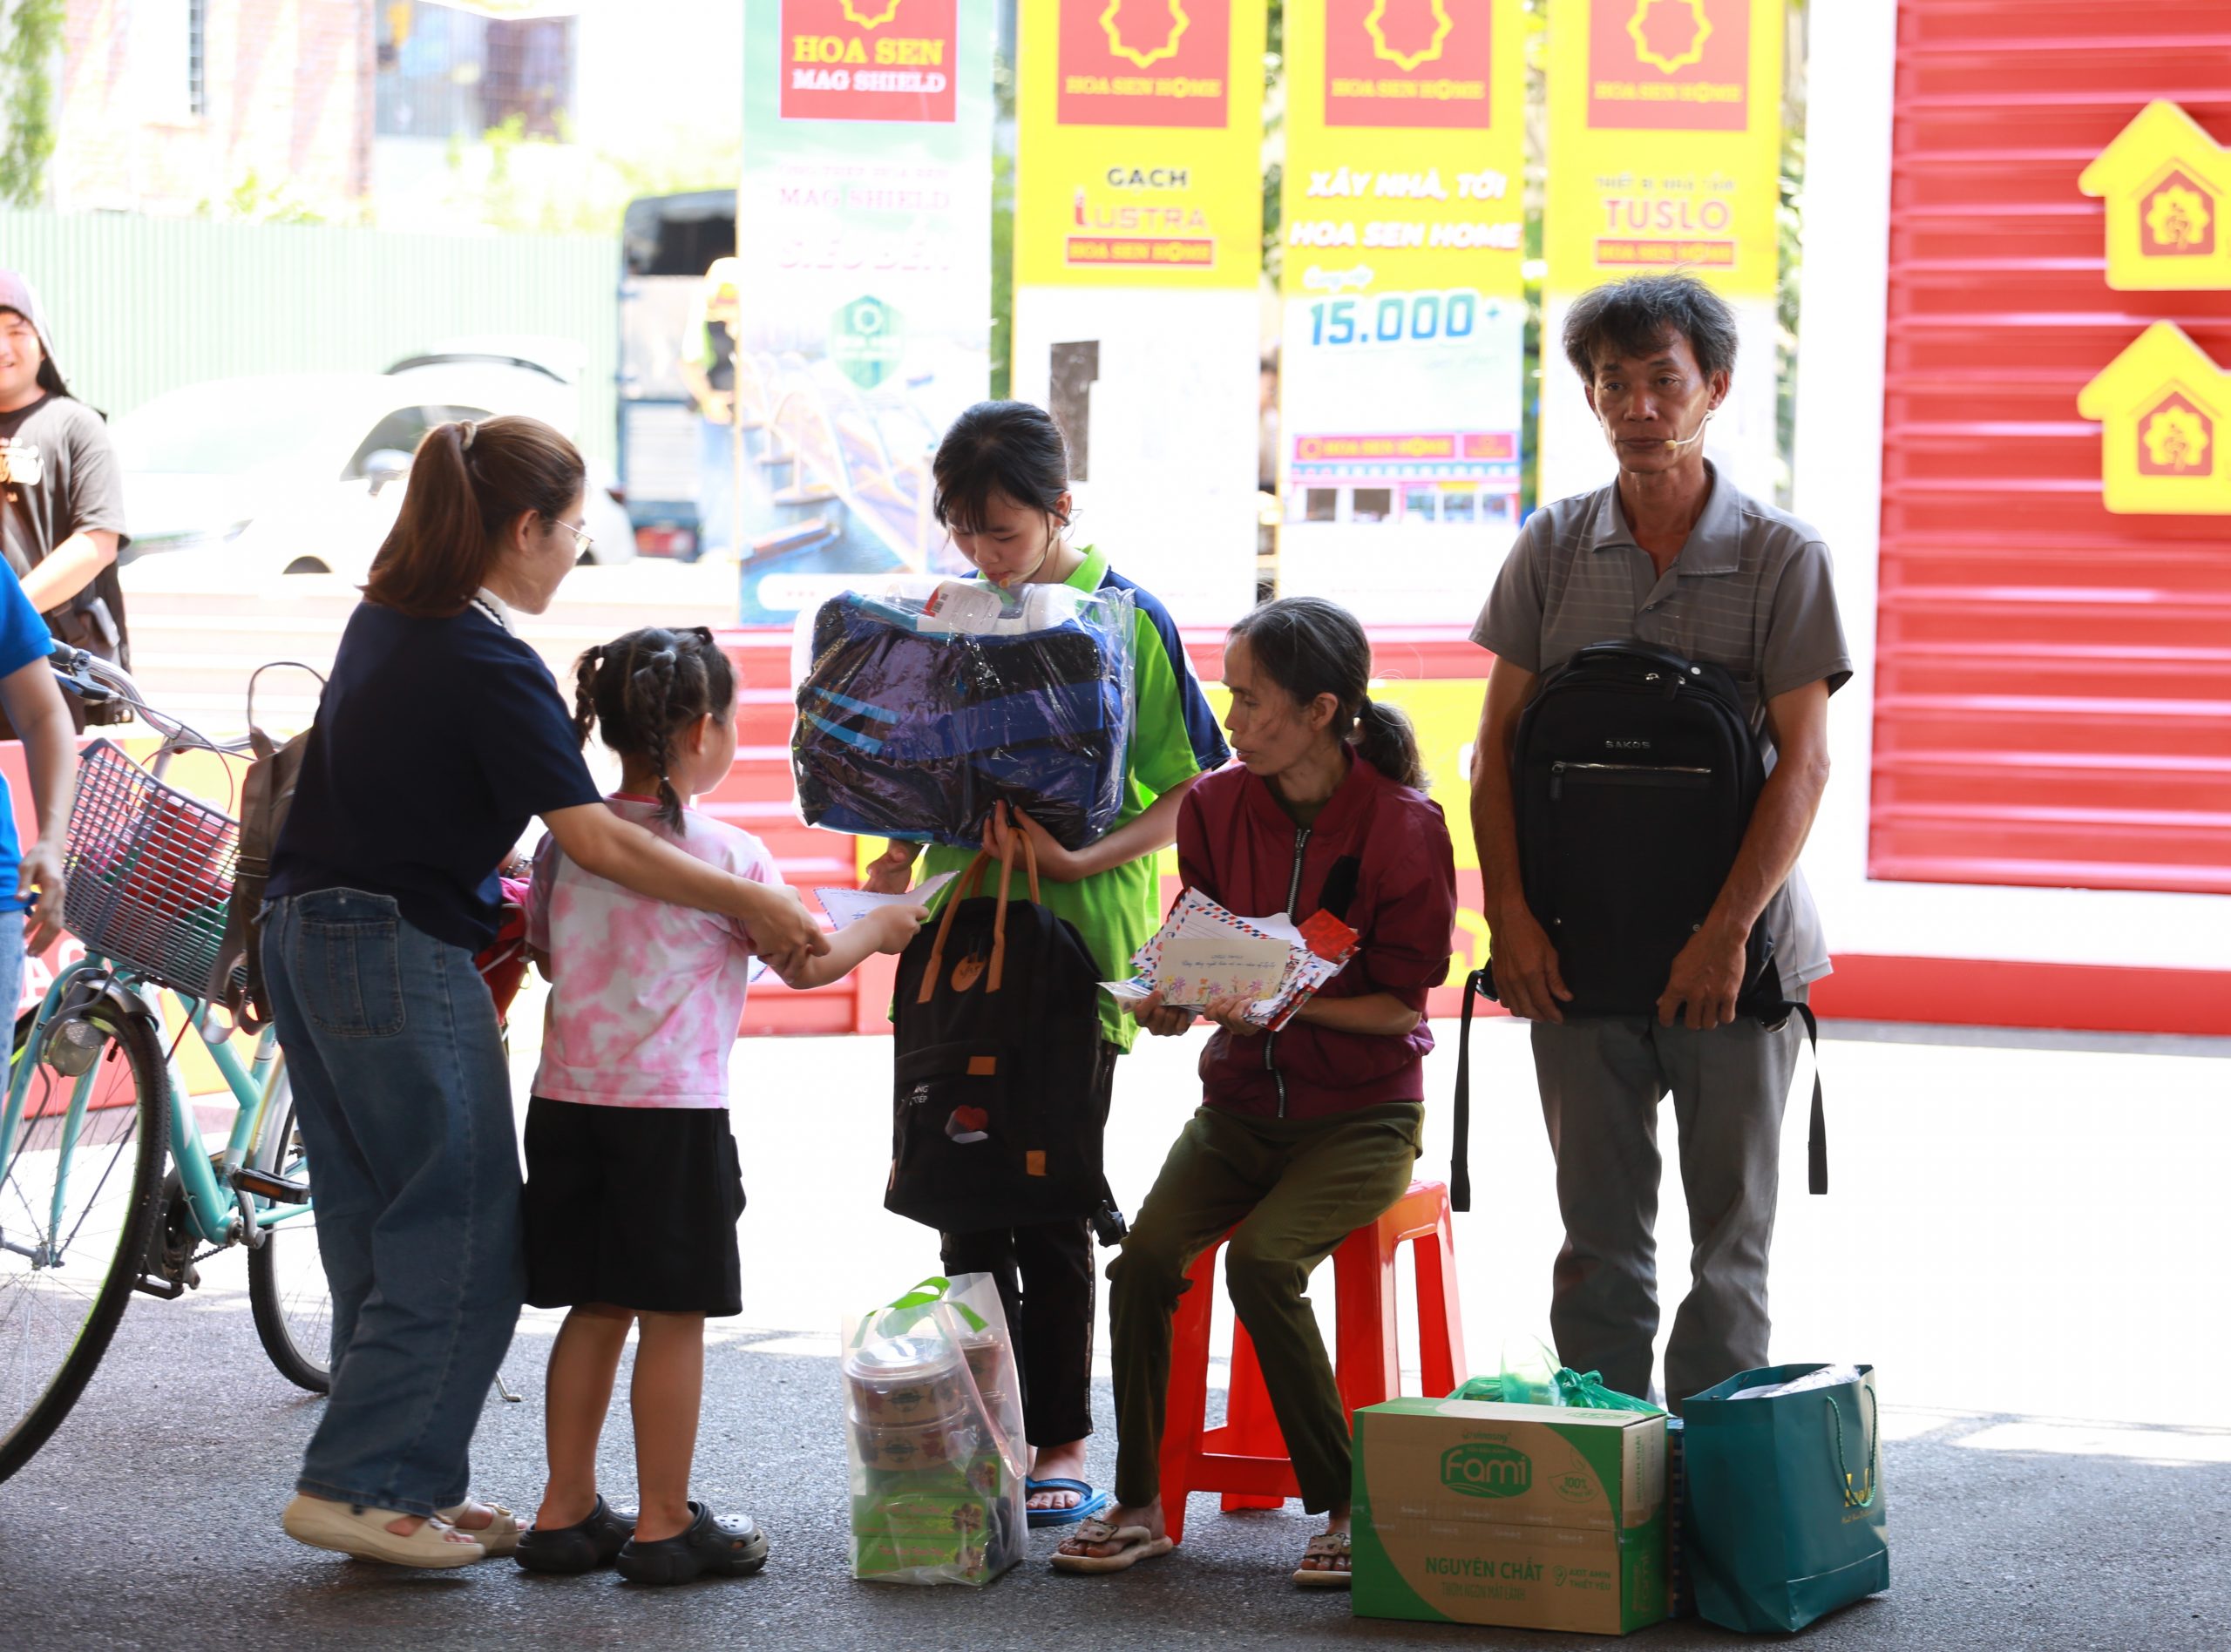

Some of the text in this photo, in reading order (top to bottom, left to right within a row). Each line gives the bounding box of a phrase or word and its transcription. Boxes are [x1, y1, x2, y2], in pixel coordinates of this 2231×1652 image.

[793, 35, 945, 65] HOA SEN
[792, 69, 946, 92] MAG SHIELD
[1066, 76, 1221, 98] HOA SEN HOME
[1332, 78, 1484, 100] HOA SEN HOME
[1594, 81, 1635, 100] HOA
[1638, 82, 1677, 101] SEN
[780, 187, 950, 210] MAG SHIELD
[1607, 200, 1730, 230] TUSLO
[1289, 221, 1522, 250] HOA SEN HOME
[1605, 741, 1651, 749] SAKOS
[1425, 1556, 1544, 1581] NGUYÊN CHẤT
